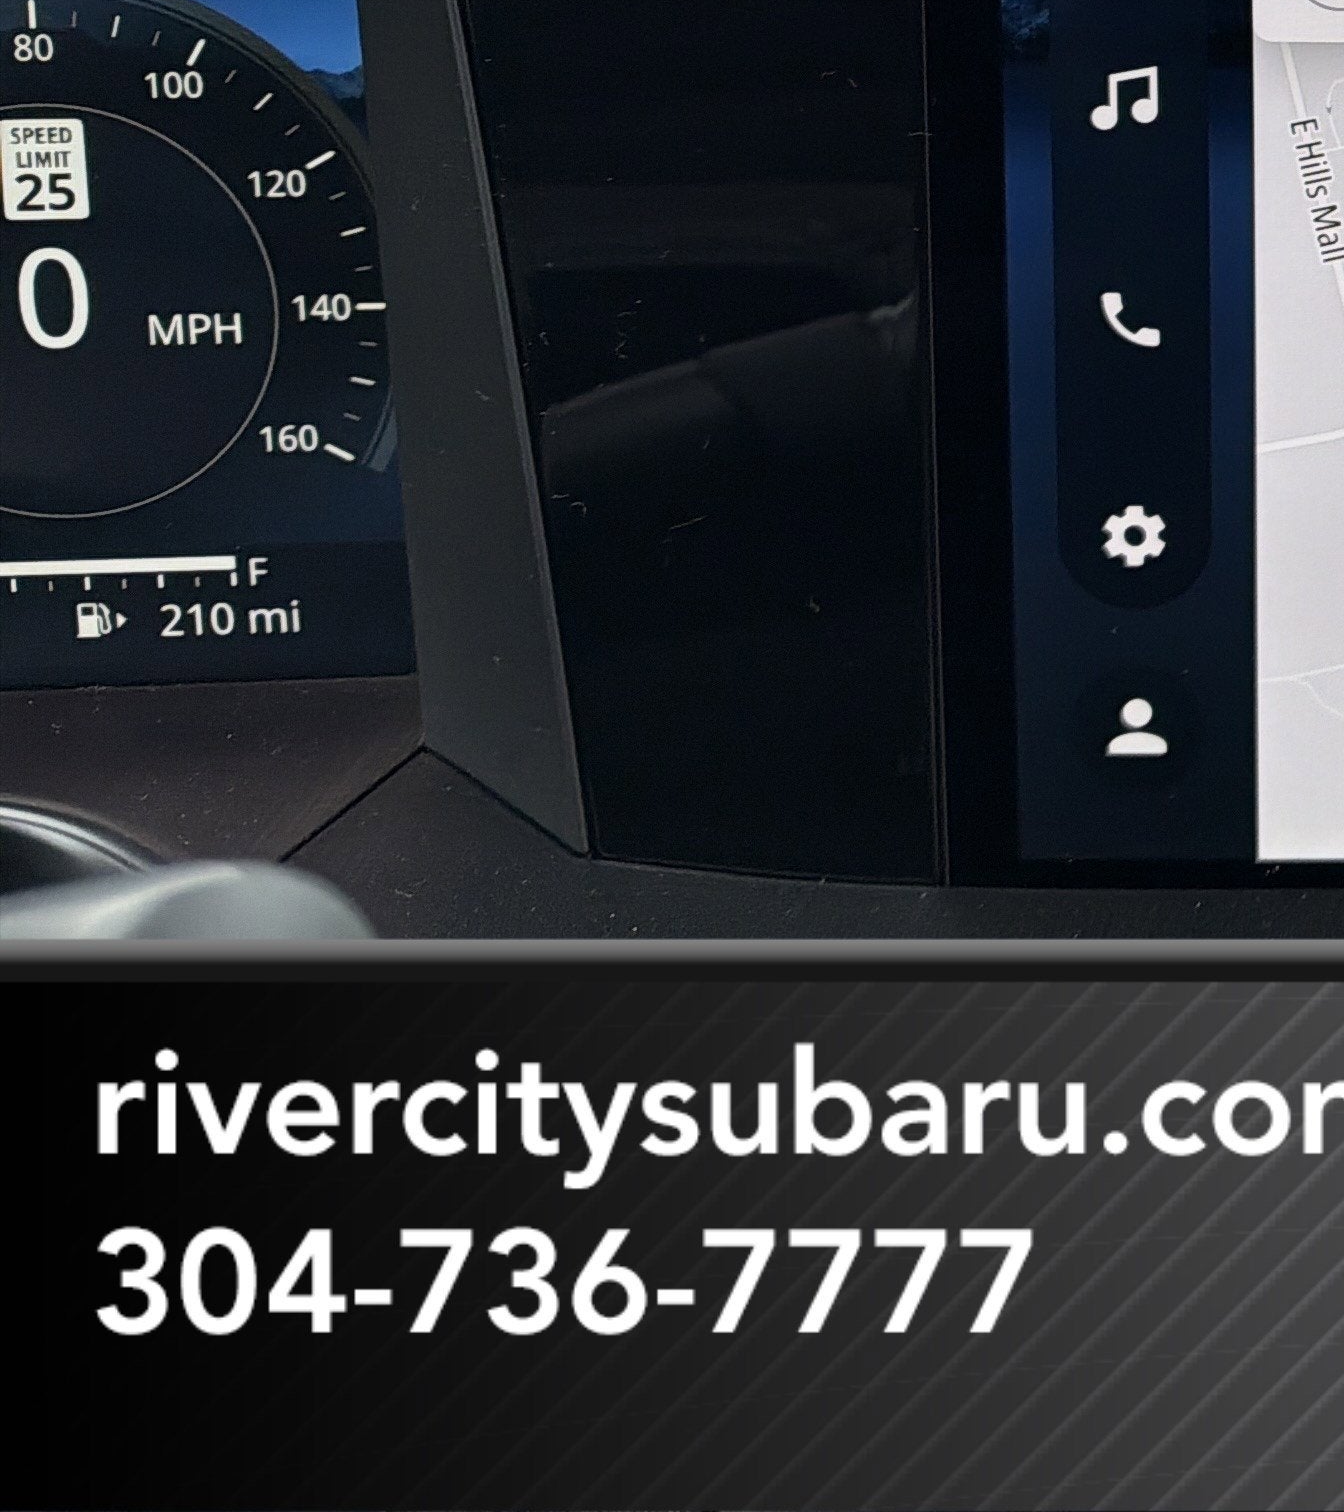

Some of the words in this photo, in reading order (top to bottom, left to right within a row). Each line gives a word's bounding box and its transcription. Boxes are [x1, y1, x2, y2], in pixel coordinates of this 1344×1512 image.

[13, 34, 54, 63] 80
[144, 71, 204, 99] 100
[10, 126, 73, 145] SPEED
[1290, 118, 1319, 135] E
[15, 150, 72, 169] LIMIT
[1295, 140, 1333, 199] Hills
[15, 172, 76, 212] 25
[247, 169, 306, 198] 120
[18, 247, 89, 349] 0
[291, 293, 352, 322] 140
[148, 312, 243, 346] MPH
[259, 424, 319, 453] 160
[249, 557, 268, 587] F
[159, 602, 235, 637] 210
[248, 599, 301, 635] mi
